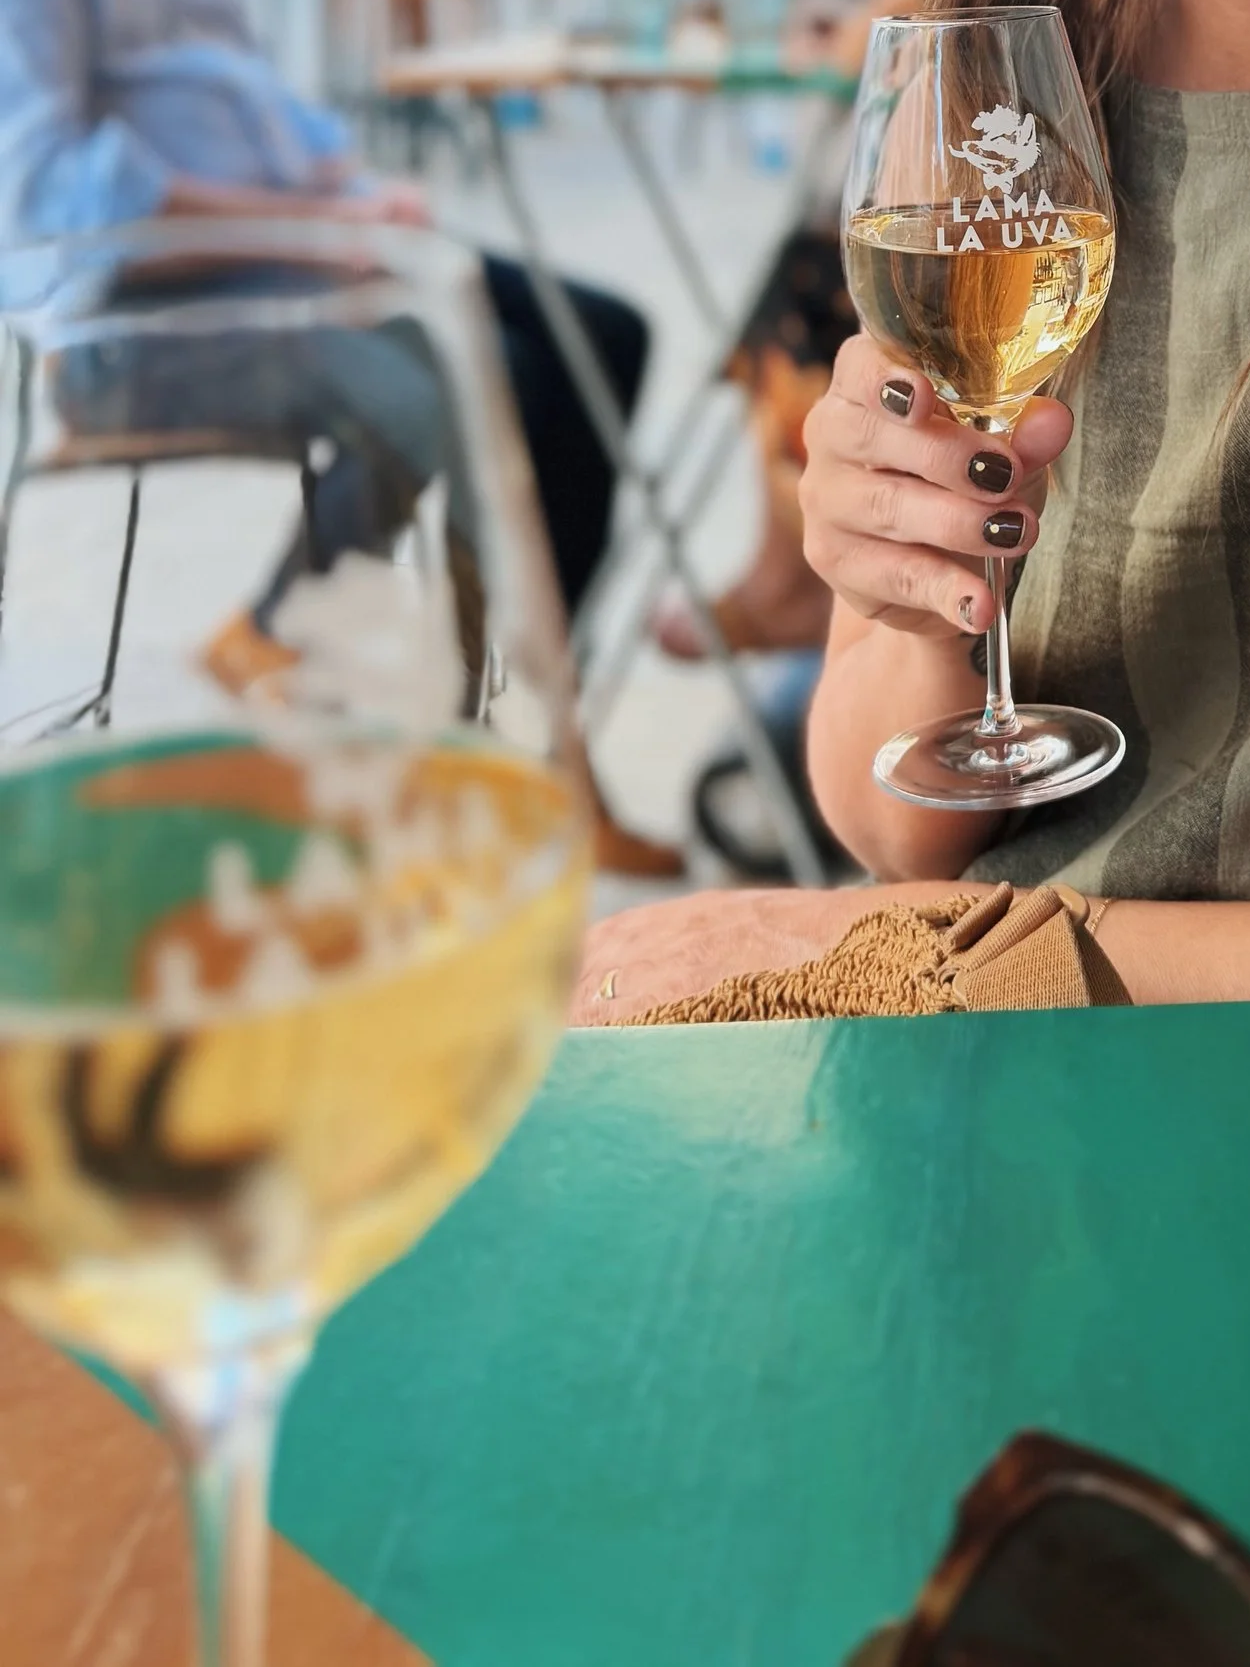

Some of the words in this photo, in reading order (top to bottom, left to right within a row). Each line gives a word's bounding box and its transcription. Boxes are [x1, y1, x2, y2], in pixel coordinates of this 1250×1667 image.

[952, 189, 1056, 223] LAMA
[936, 225, 985, 252] LA
[1002, 215, 1072, 248] UVA
